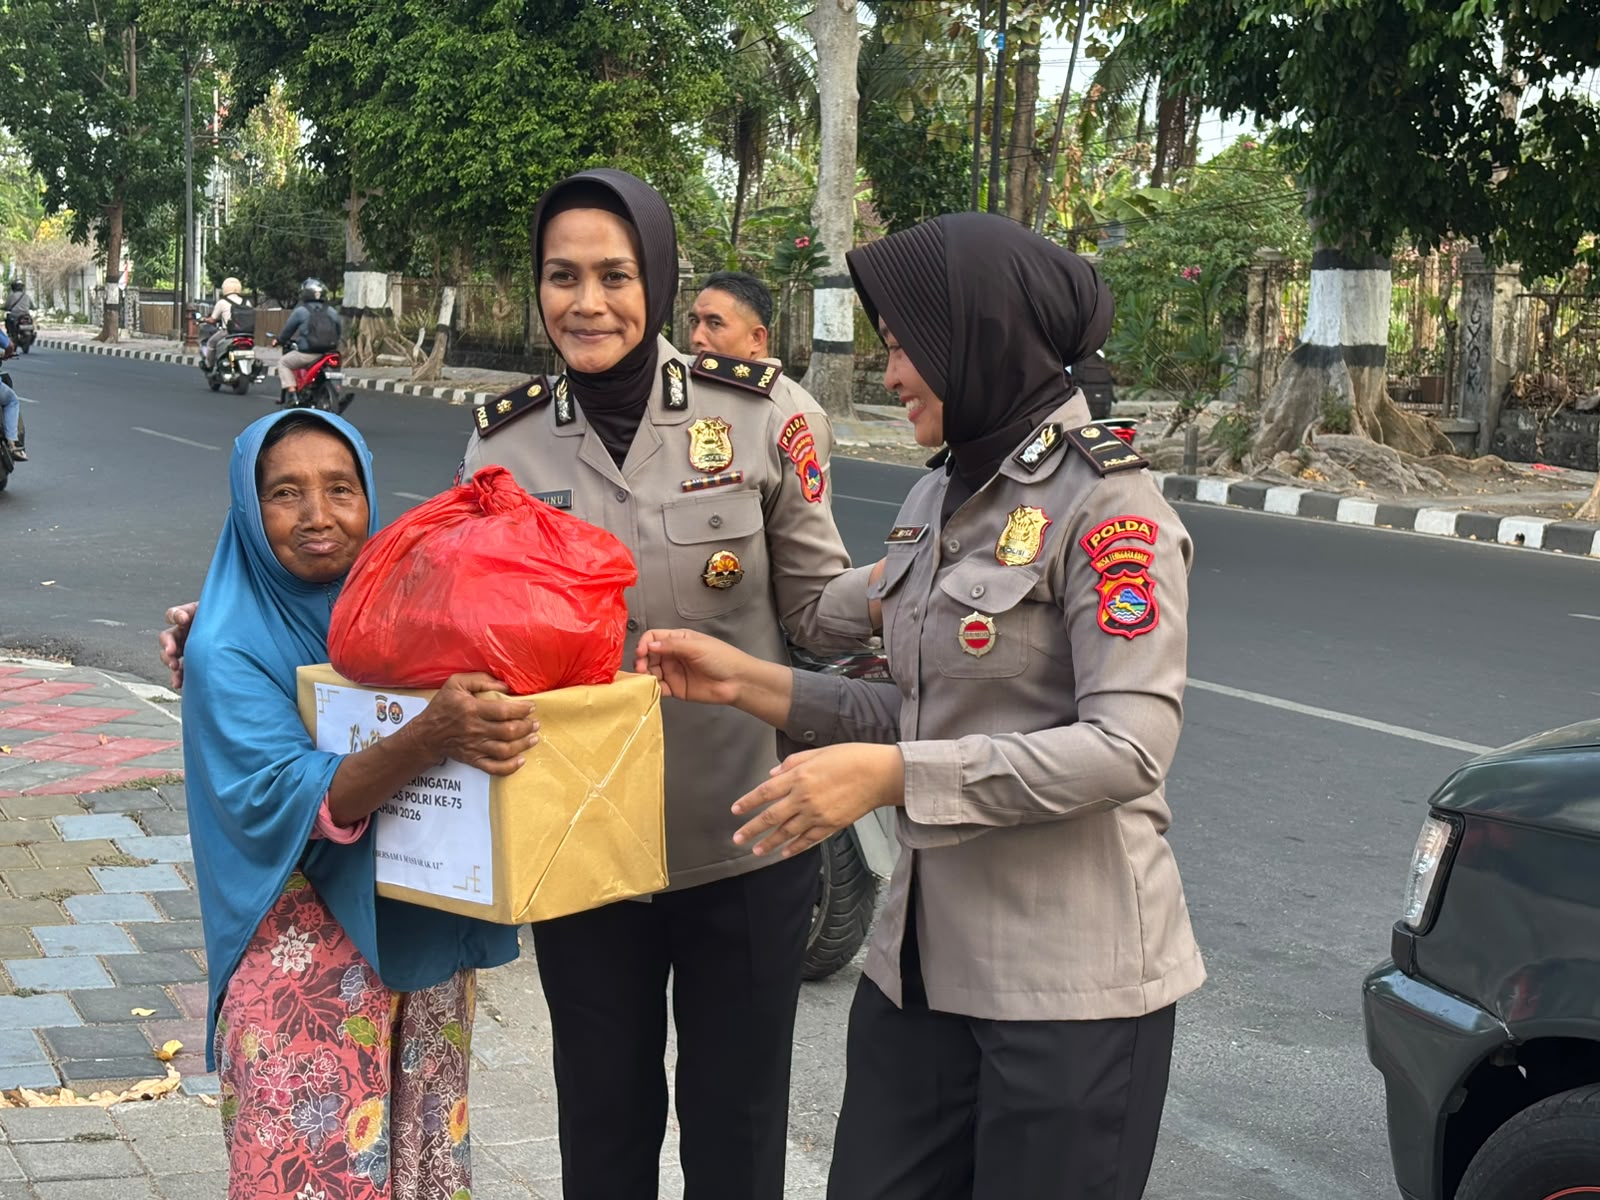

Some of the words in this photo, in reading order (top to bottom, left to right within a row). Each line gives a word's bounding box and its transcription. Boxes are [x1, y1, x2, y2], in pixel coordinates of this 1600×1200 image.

[757, 366, 776, 388] POLISI
[476, 406, 489, 429] POLISI
[782, 417, 806, 446] POLDA
[1090, 520, 1151, 547] POLDA
[378, 802, 398, 816] AHUN
[400, 806, 421, 821] 2026
[405, 791, 432, 806] POLRI
[434, 794, 462, 810] KE-75
